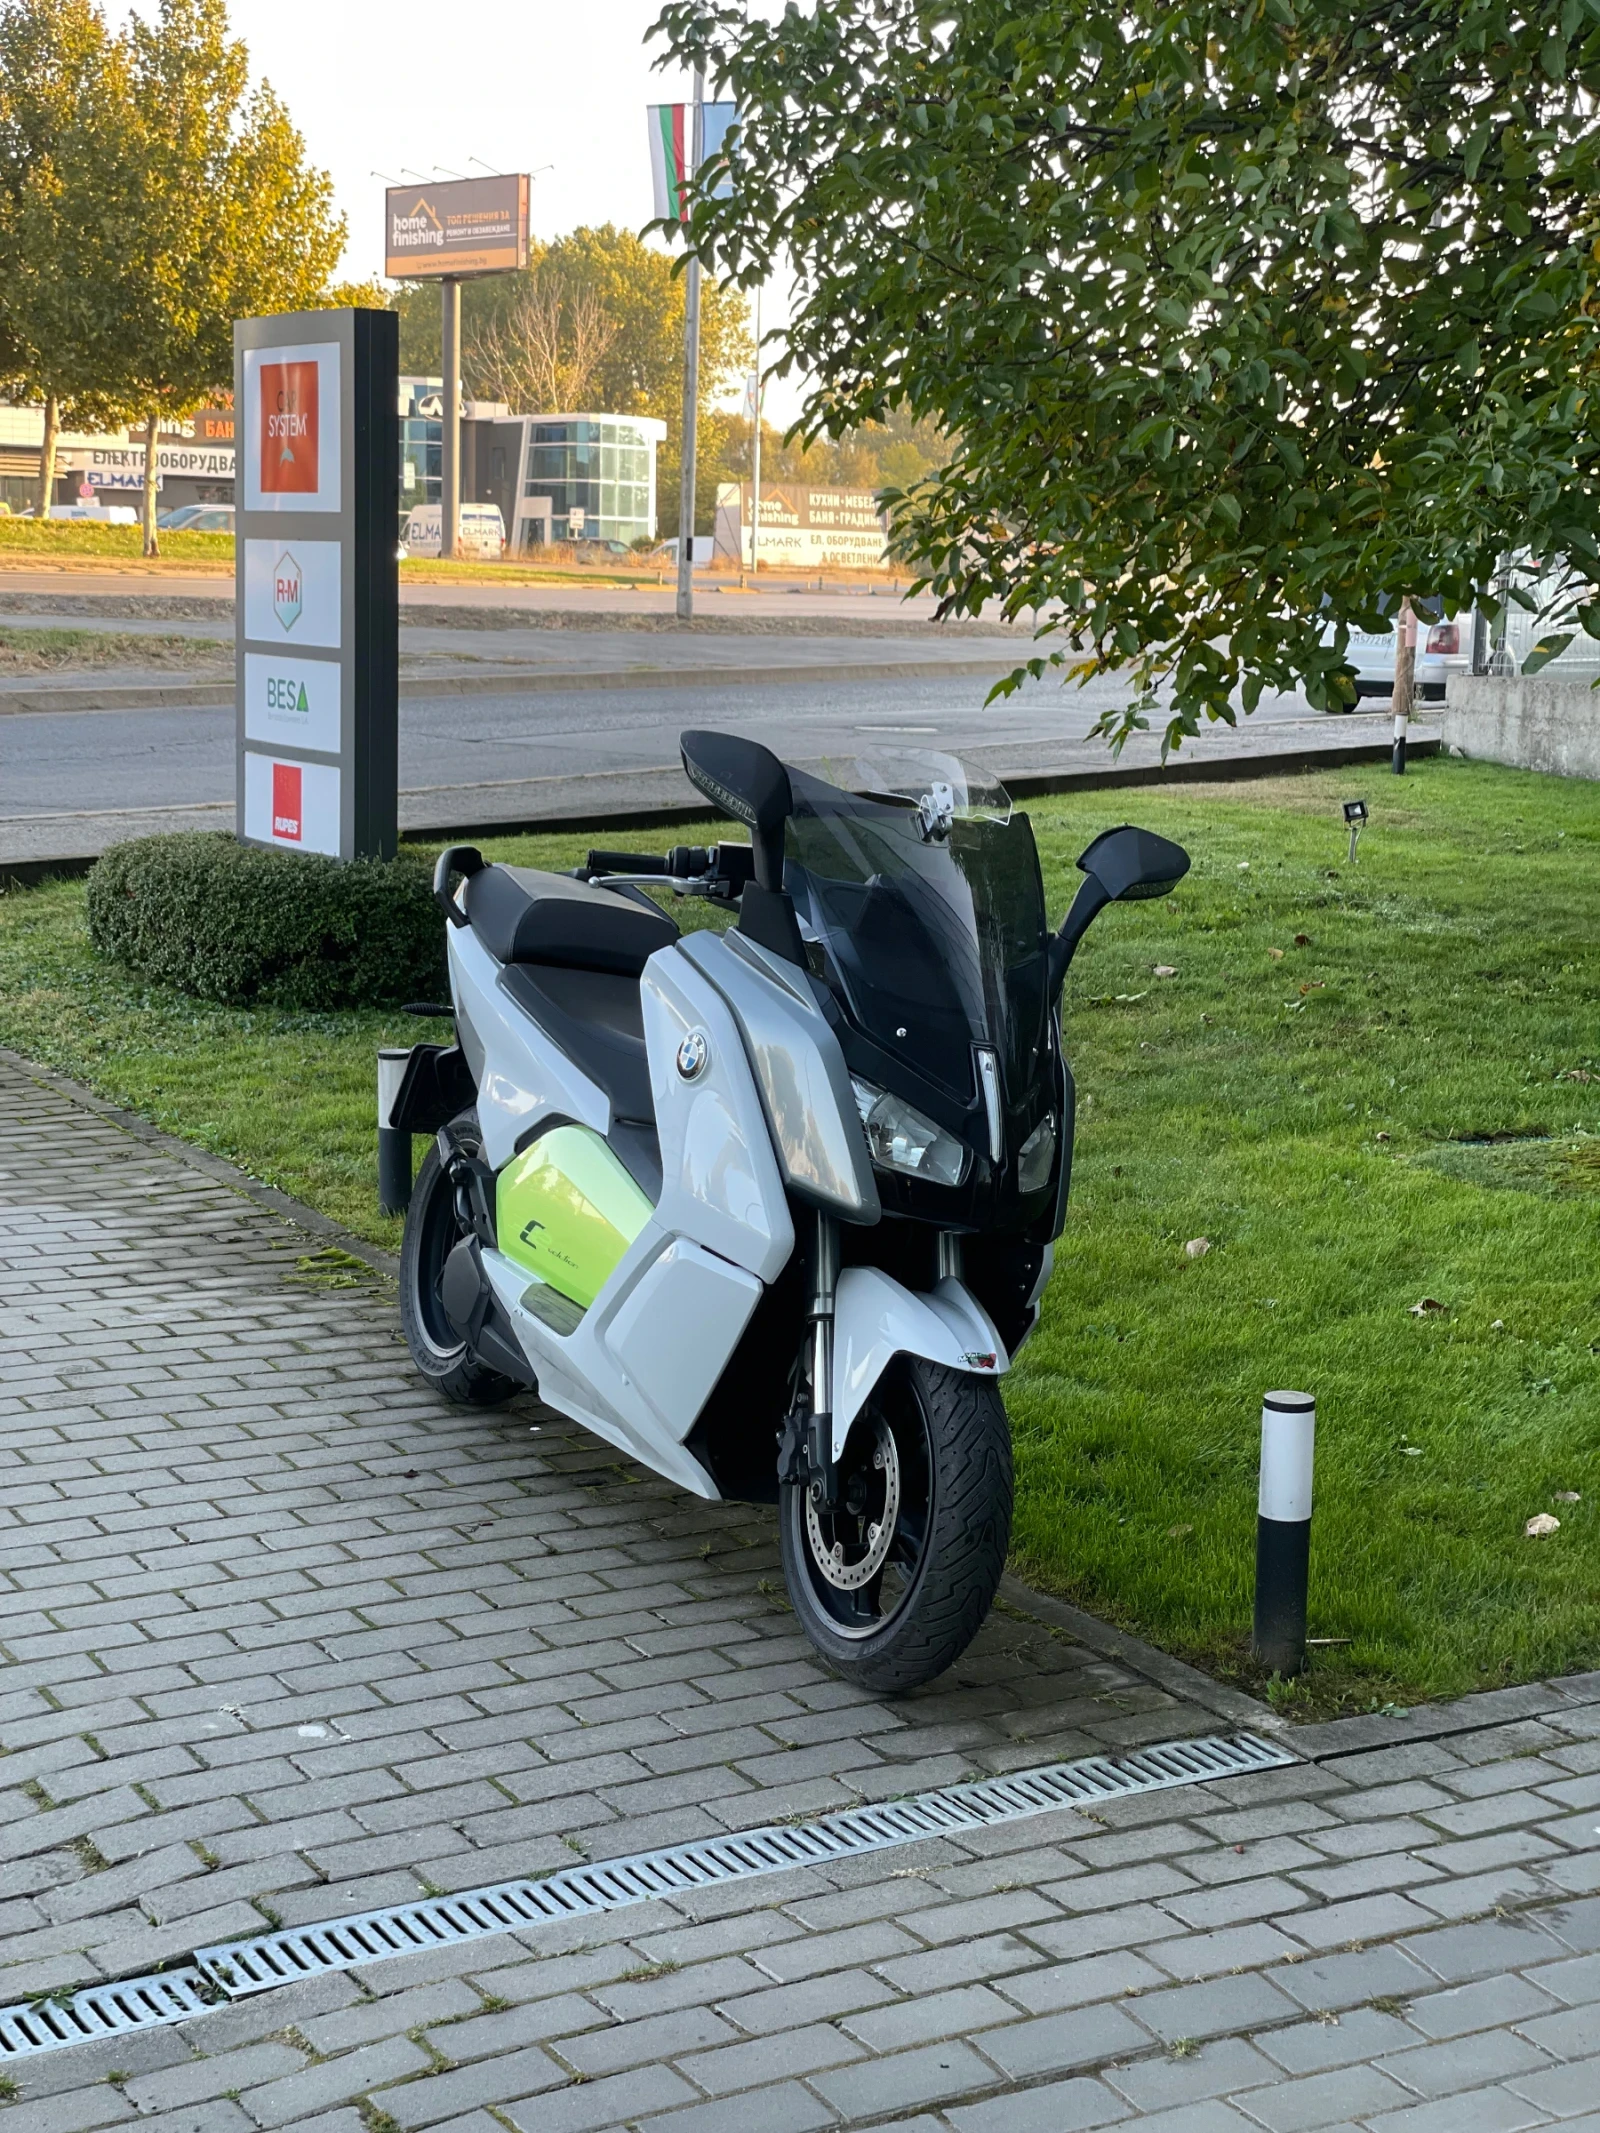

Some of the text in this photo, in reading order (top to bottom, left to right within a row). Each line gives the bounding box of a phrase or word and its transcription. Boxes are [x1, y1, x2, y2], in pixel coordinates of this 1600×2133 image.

[393, 213, 428, 231] home
[446, 215, 462, 225] ТОП
[463, 211, 499, 224] РЕШЕНИЯ
[392, 229, 445, 247] finishing
[809, 493, 879, 509] КУХНИ МЕБЕЛ
[809, 510, 835, 525] БАНЯ
[829, 551, 884, 566] ОСВЕТЛЕНИ
[276, 578, 299, 603] R-M
